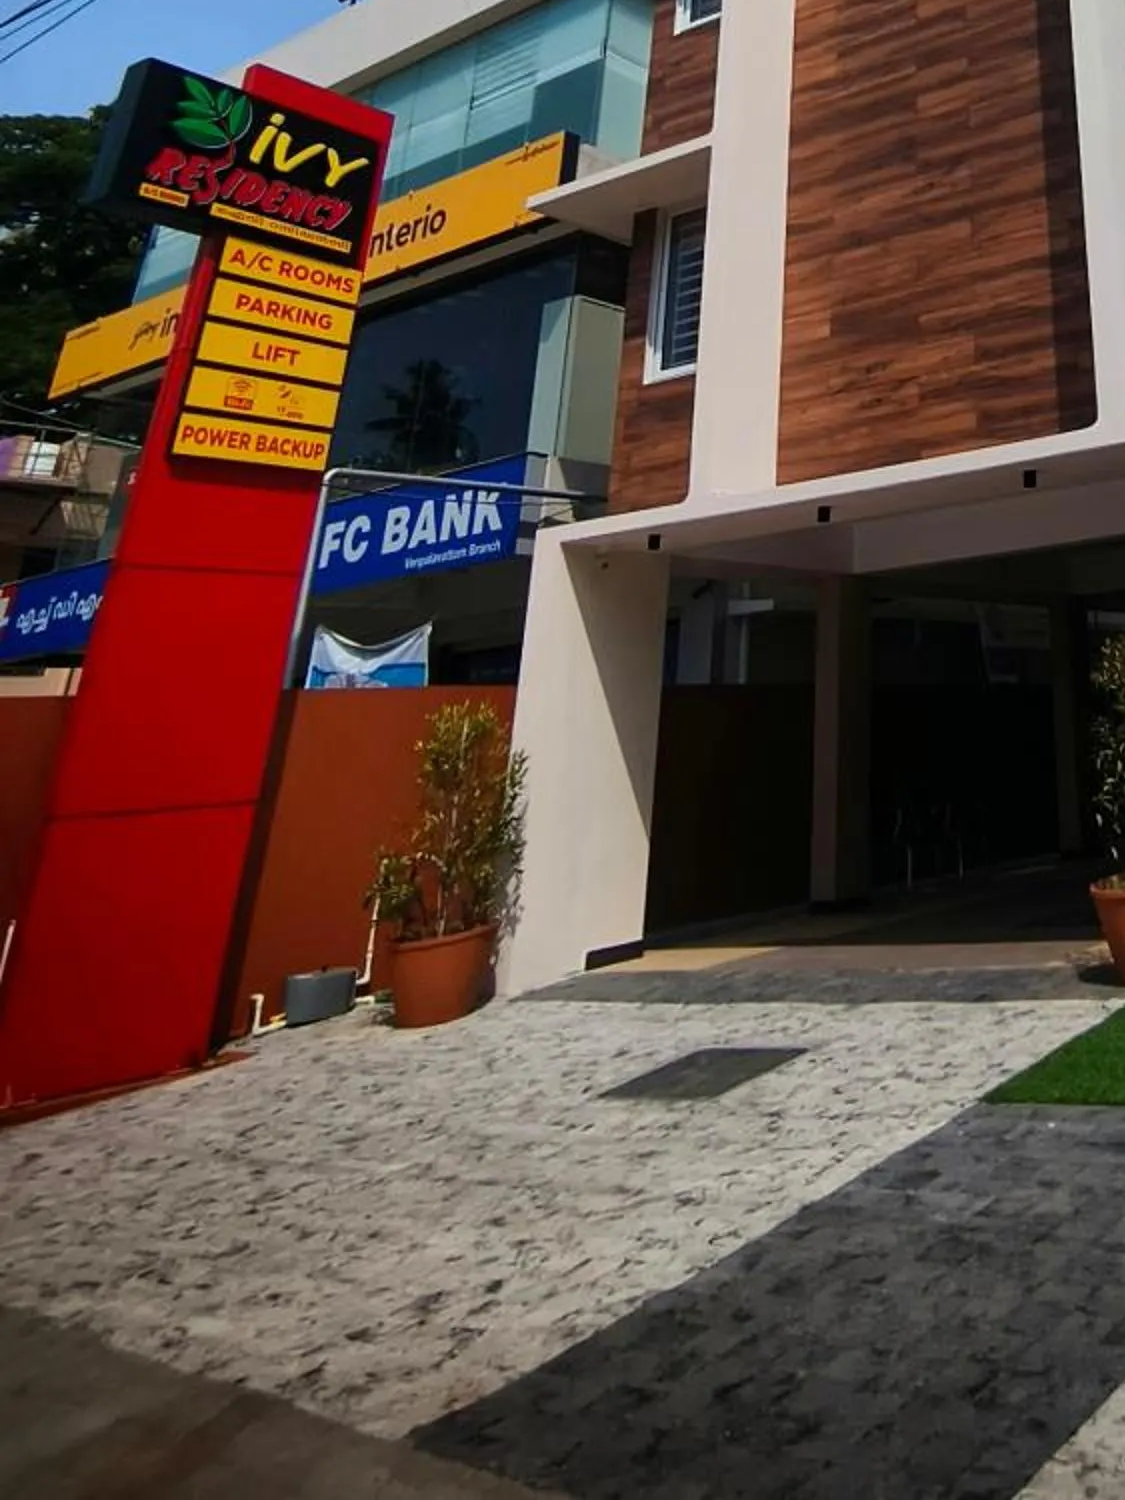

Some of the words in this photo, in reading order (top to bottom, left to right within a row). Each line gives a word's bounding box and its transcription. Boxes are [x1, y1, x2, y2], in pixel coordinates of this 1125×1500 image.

[145, 146, 353, 231] RESIDENCY
[229, 247, 275, 273] A/C
[278, 260, 355, 294] ROOMS
[234, 293, 334, 331] PARKING
[251, 341, 301, 367] LIFT
[180, 425, 252, 451] POWER
[255, 433, 326, 461] BACKUP
[380, 489, 503, 556] BANK
